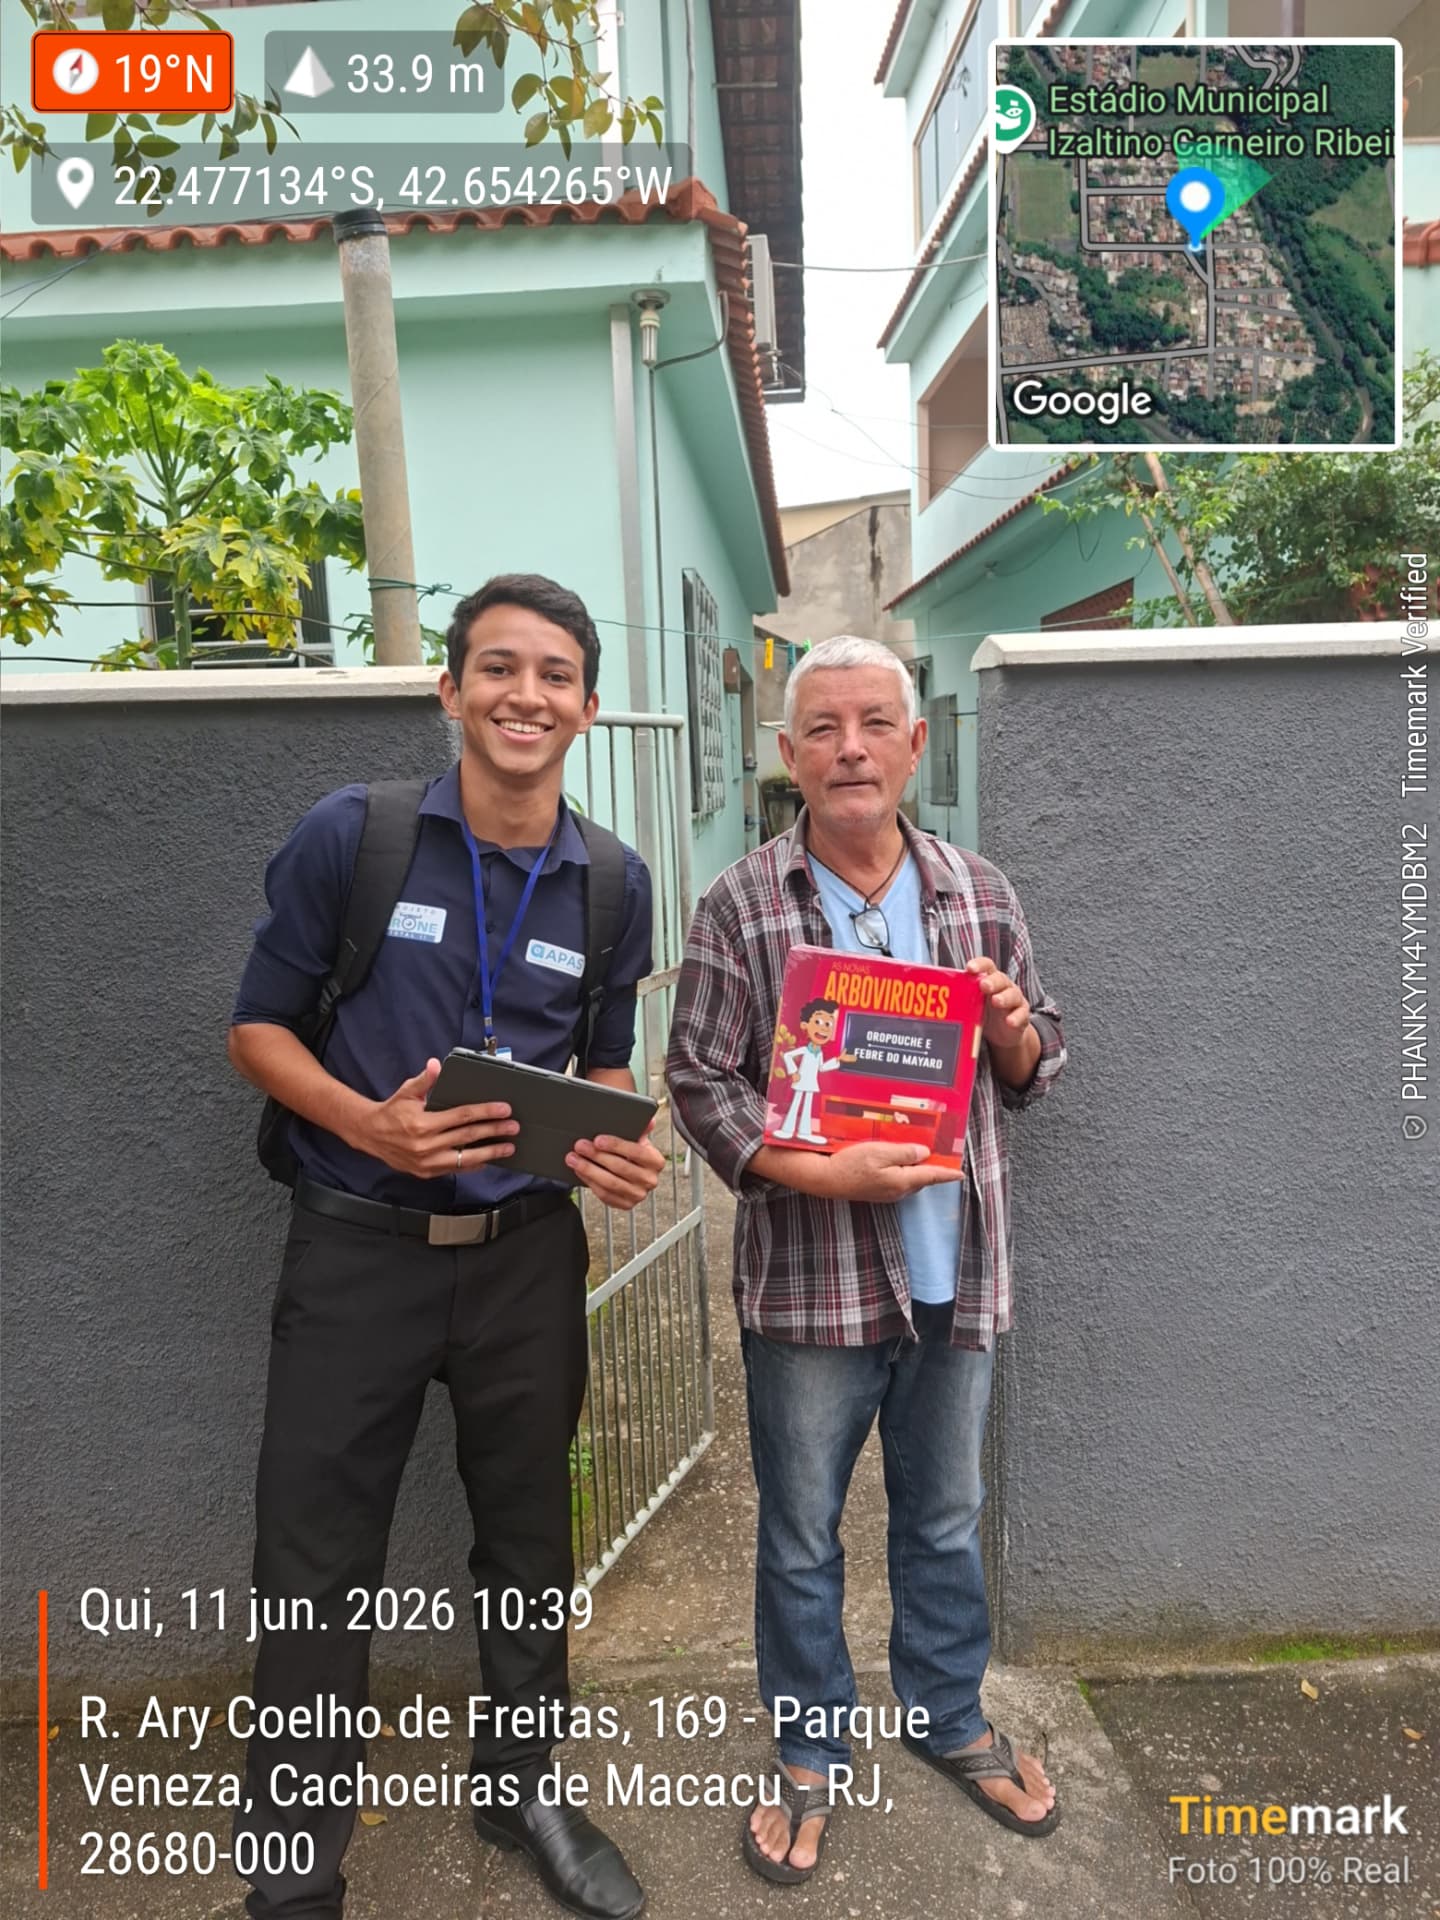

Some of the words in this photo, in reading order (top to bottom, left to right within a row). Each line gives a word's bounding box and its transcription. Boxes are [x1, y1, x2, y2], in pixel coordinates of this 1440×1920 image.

[824, 970, 950, 1019] ARBOVIROSES
[866, 1030, 923, 1049] OROPOUCHE
[925, 1038, 932, 1049] E
[854, 1047, 883, 1061] FEBRE
[886, 1051, 900, 1063] DO
[902, 1054, 943, 1070] MAYARO
